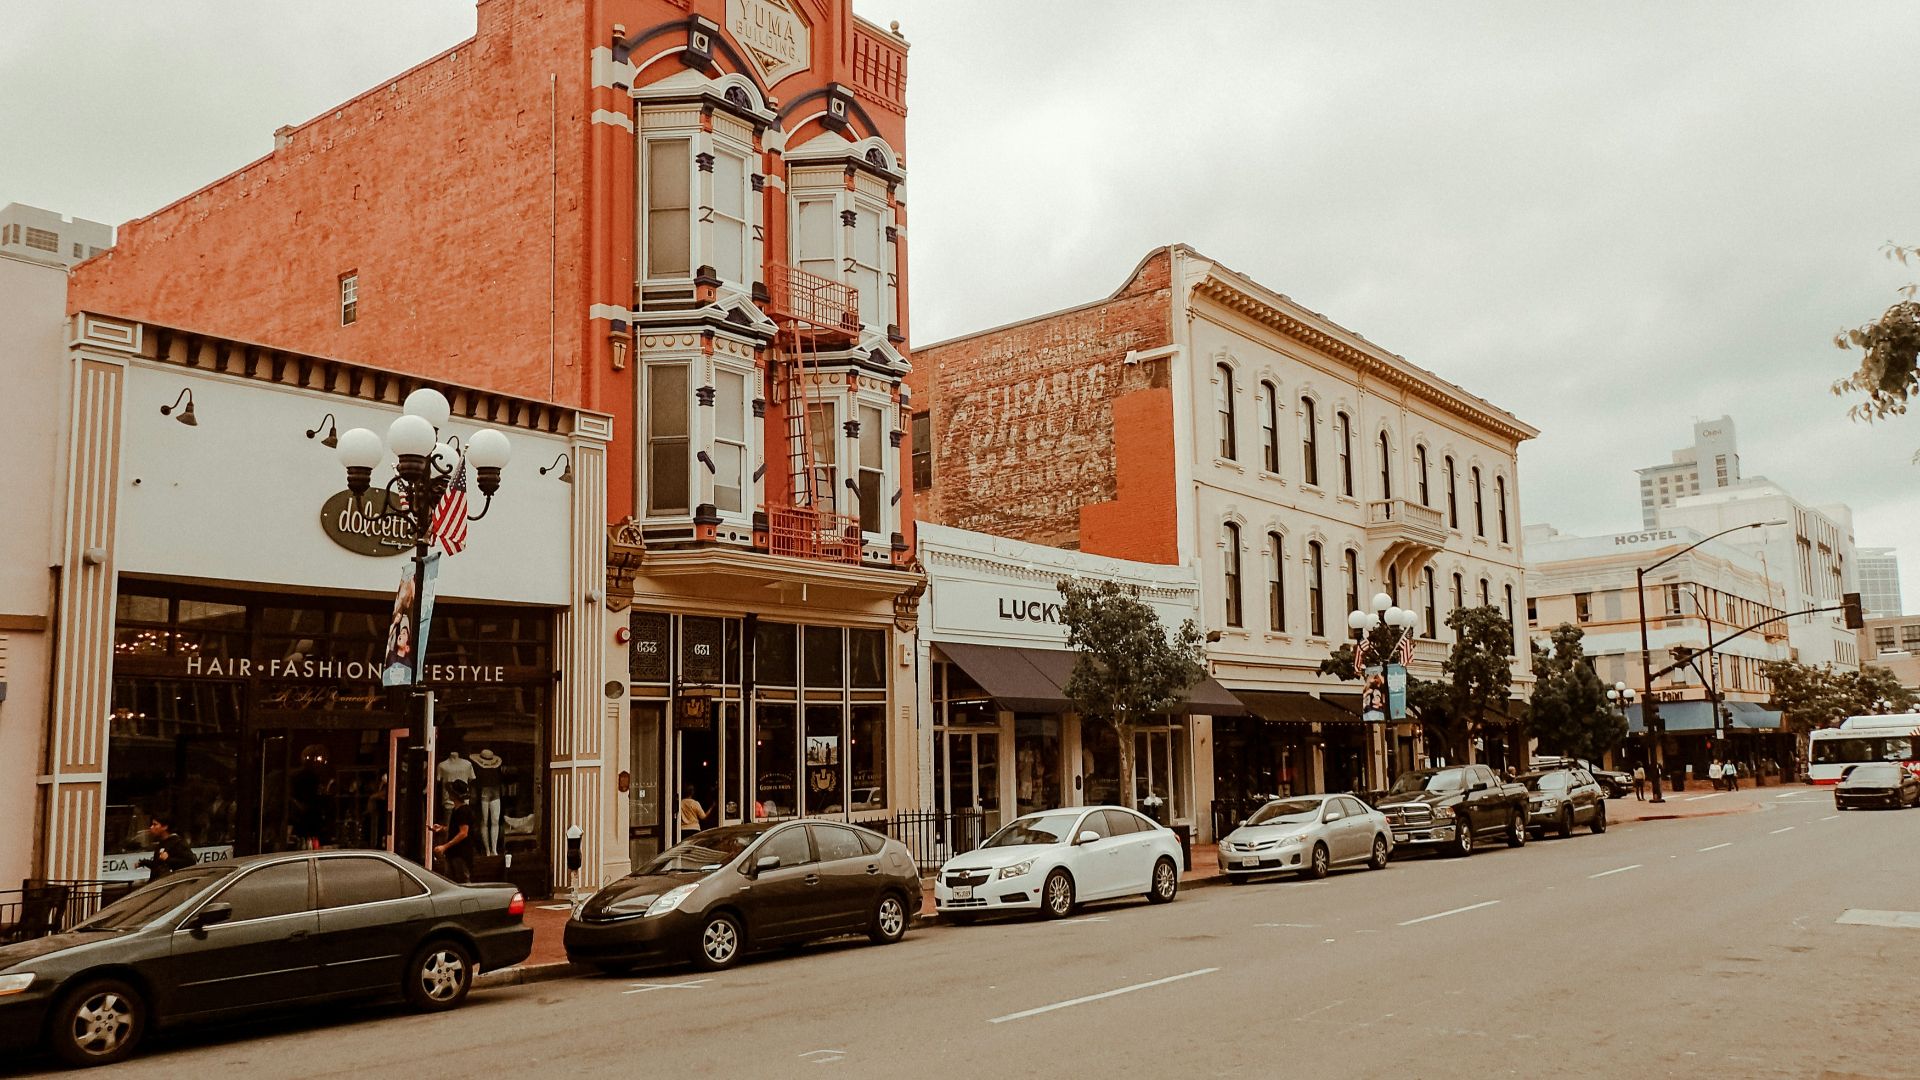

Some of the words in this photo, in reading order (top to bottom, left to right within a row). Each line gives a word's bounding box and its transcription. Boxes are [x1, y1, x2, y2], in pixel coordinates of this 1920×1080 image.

[740, 0, 795, 44] YUMA
[1615, 530, 1677, 545] HOSTEL
[637, 641, 657, 653] 633
[694, 644, 710, 656] 631
[186, 657, 251, 676] HAIR
[271, 659, 383, 680] FASHION
[425, 664, 504, 682] ESTYLE
[195, 850, 228, 864] VEDA
[102, 860, 129, 873] EDA
